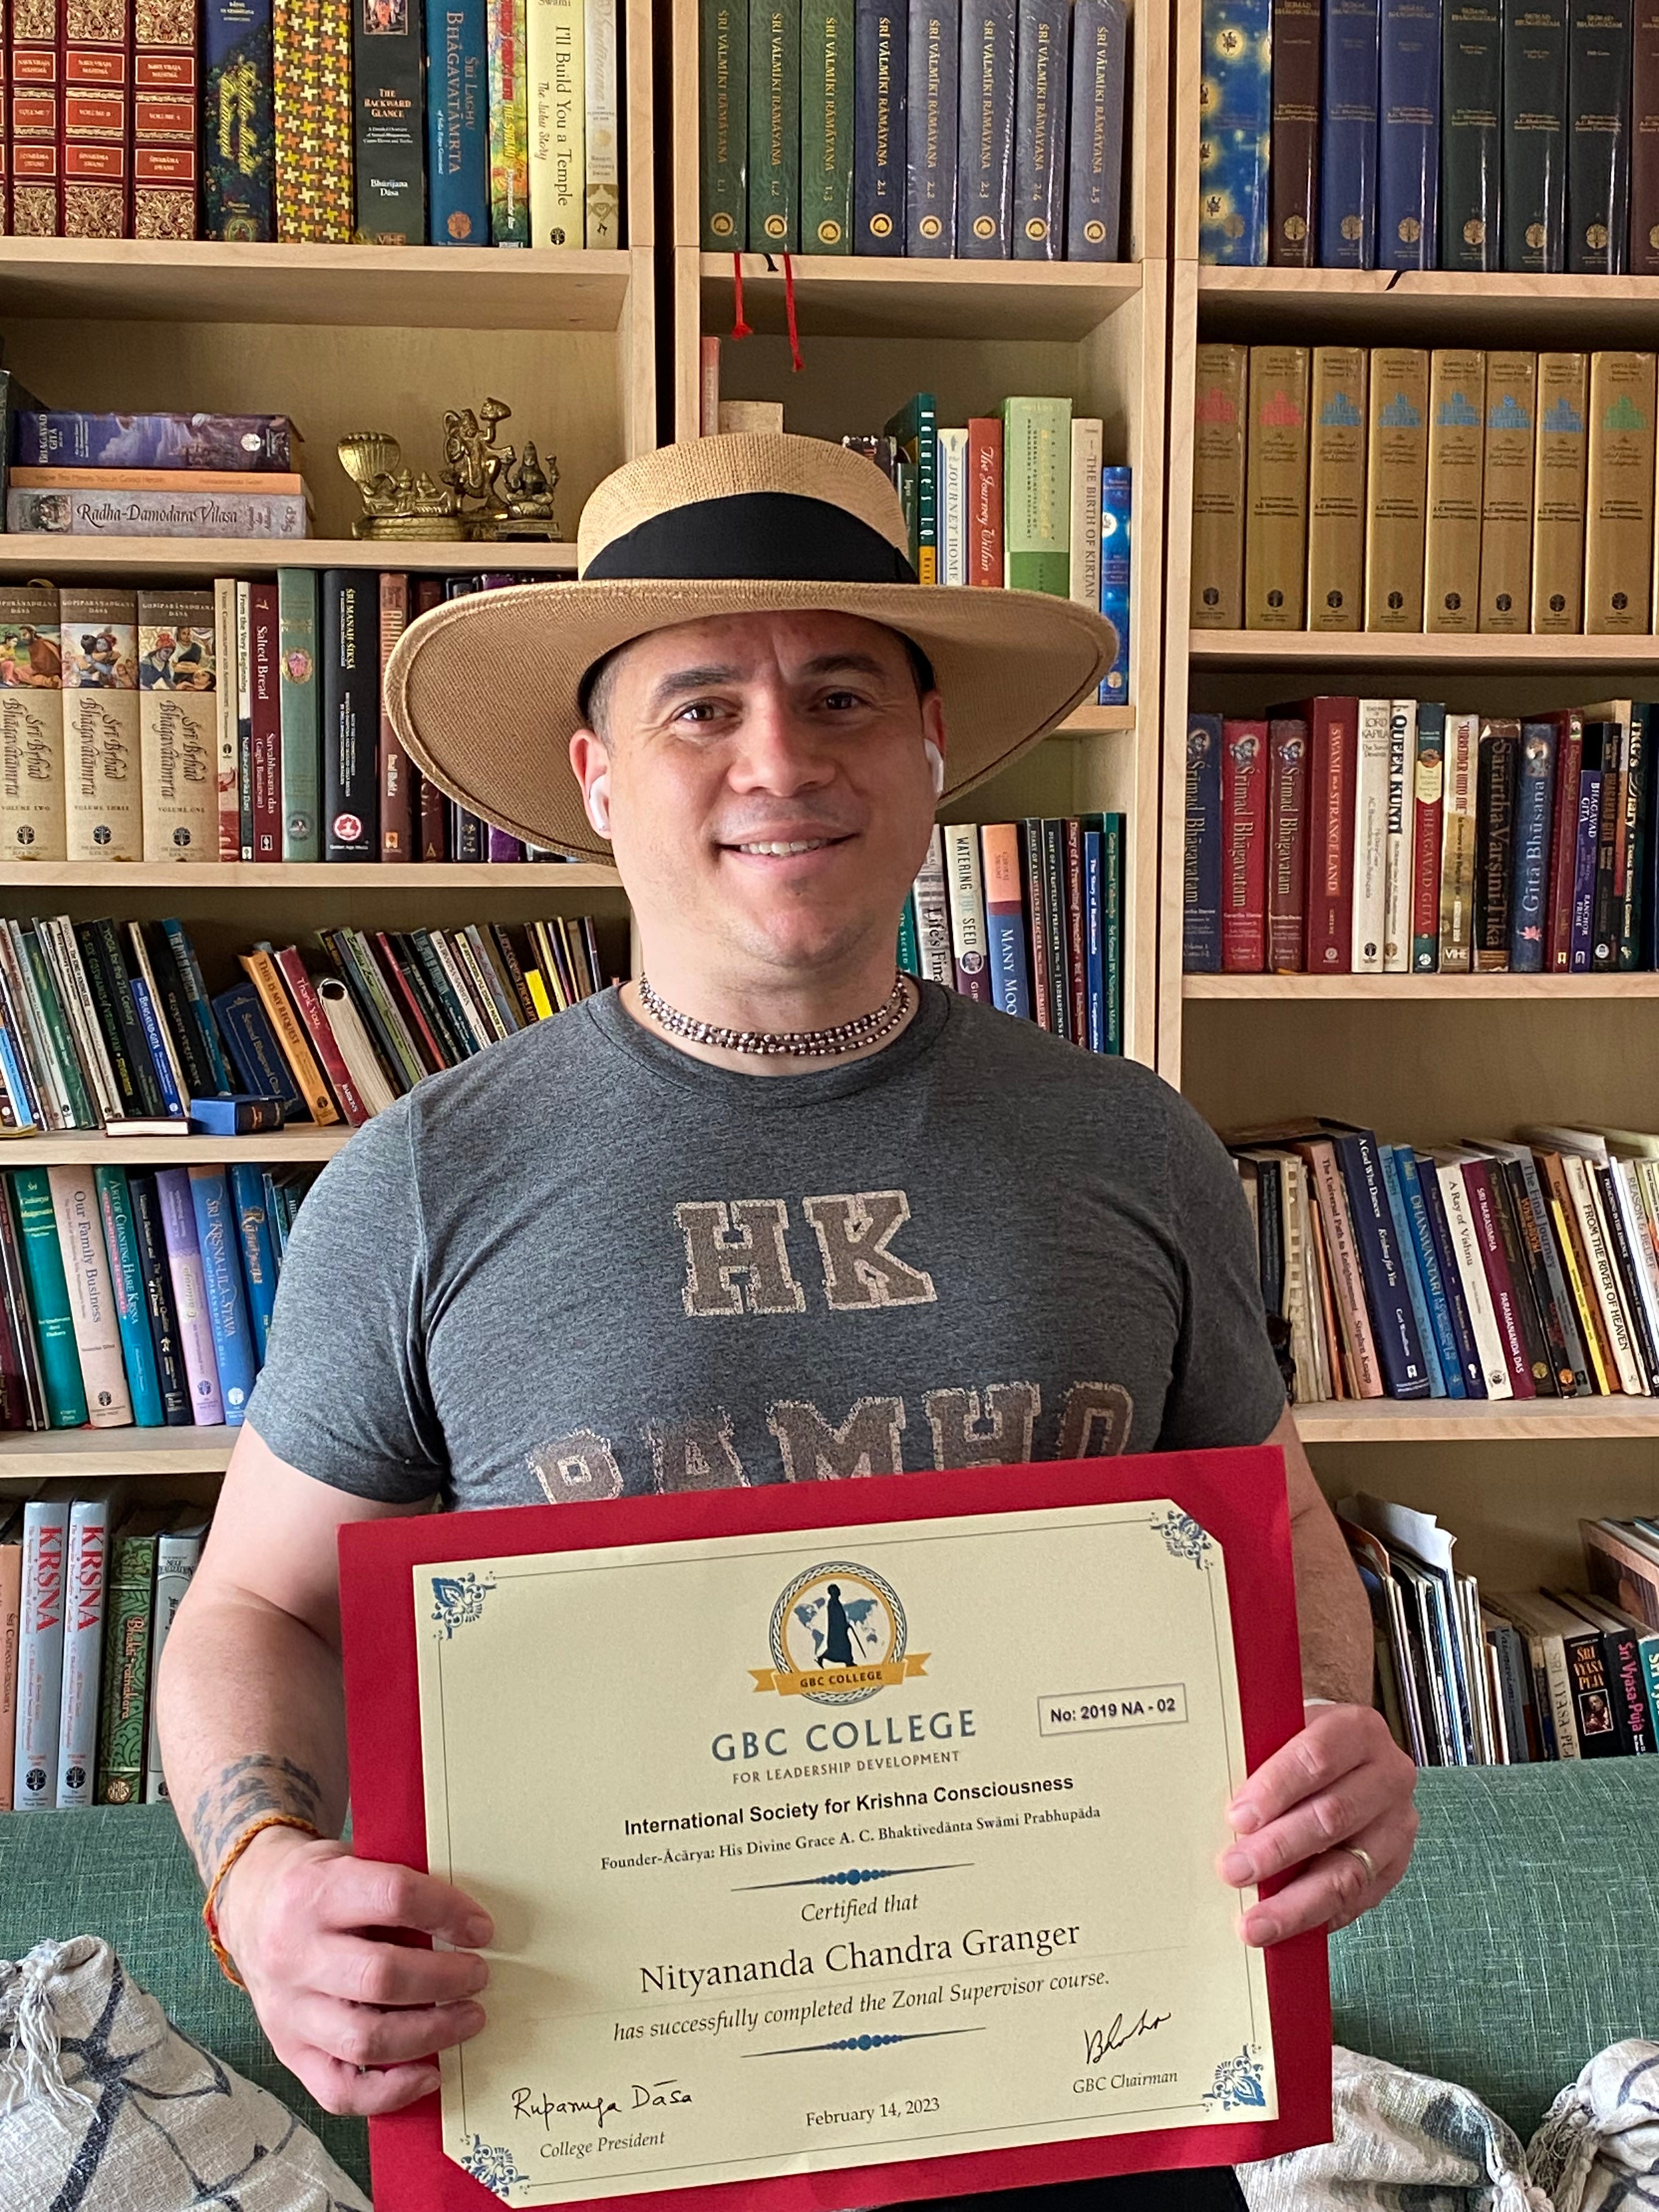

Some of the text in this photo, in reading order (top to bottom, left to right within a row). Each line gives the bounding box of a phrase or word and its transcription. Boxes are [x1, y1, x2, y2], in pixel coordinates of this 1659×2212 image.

[556, 52, 572, 93] Build
[556, 98, 572, 128] You
[555, 149, 573, 206] Temple
[194, 500, 238, 523] Vilasa
[949, 466, 958, 582] JOURNEY HOME
[976, 446, 995, 572] The Journey Within
[1085, 455, 1097, 599] THE BIRTH OF KIRTAN
[256, 625, 269, 699] Salted Bread
[1362, 730, 1389, 739] KAPILA
[1365, 718, 1388, 727] LORD
[1390, 715, 1407, 774] QUEEN
[1328, 729, 1341, 891] SWAMI STRANGE LAND
[1389, 781, 1402, 834] KUNTI
[1456, 774, 1468, 795] UNTO
[1588, 783, 1600, 838] BHAGAVAD
[956, 837, 973, 890] WATERING
[1422, 809, 1434, 887] BHAGAVAD
[962, 918, 978, 946] SEED
[1582, 895, 1590, 936] RANCHOR
[1001, 929, 1015, 973] MANY
[1445, 949, 1467, 959] VIHE
[259, 960, 272, 985] THIS
[271, 990, 283, 1007] MY
[279, 1005, 300, 1045] REQUEST
[1361, 1147, 1372, 1165] God
[1327, 1177, 1340, 1216] Universal
[1334, 1219, 1344, 1238] Path
[1449, 1181, 1473, 1266] A Ray of Vishnu
[1523, 1164, 1556, 1269] The Final Journey
[1627, 1177, 1644, 1220] REASON
[1641, 1233, 1657, 1269] BELIEF
[74, 1190, 101, 1323] Our Family Business
[115, 1214, 130, 1265] CHANTING
[123, 1263, 135, 1294] HARE
[1583, 1204, 1630, 1351] FROM THE RIVER OF HEAVEN
[1362, 1356, 1372, 1384] Knapp
[1514, 1357, 1524, 1374] DAS
[799, 1671, 883, 1689] GBC COLLEGE
[1551, 1652, 1562, 1673] SRI
[710, 1709, 978, 1763] GBC COLLEGE
[1050, 1708, 1077, 1723] No:
[1081, 1703, 1118, 1720] 2019
[1121, 1701, 1144, 1716] NA
[1156, 1698, 1176, 1713] 02
[732, 1751, 961, 1785] FOR LEADERSHIP DEVELOPMENT
[624, 1776, 1074, 1836] International Society for Krishna Consciousness
[719, 1842, 743, 1858] His
[747, 1836, 791, 1855] Divine
[795, 1833, 835, 1850] Grace
[839, 1831, 855, 1846] A.
[859, 1829, 874, 1843] C.
[878, 1820, 973, 1841] Bhaktivedānta
[1023, 1806, 1101, 1830] Prabhupāda
[801, 1893, 918, 1924] Certified that
[640, 1923, 1080, 1996] Nityananda Chandra Granger
[613, 1971, 1110, 2042] has successfully completed the Zonal Supervisor course.
[1073, 2073, 1178, 2094] GBC Chairman
[806, 2098, 940, 2128] February 14, 2023
[540, 2131, 665, 2159] College President
